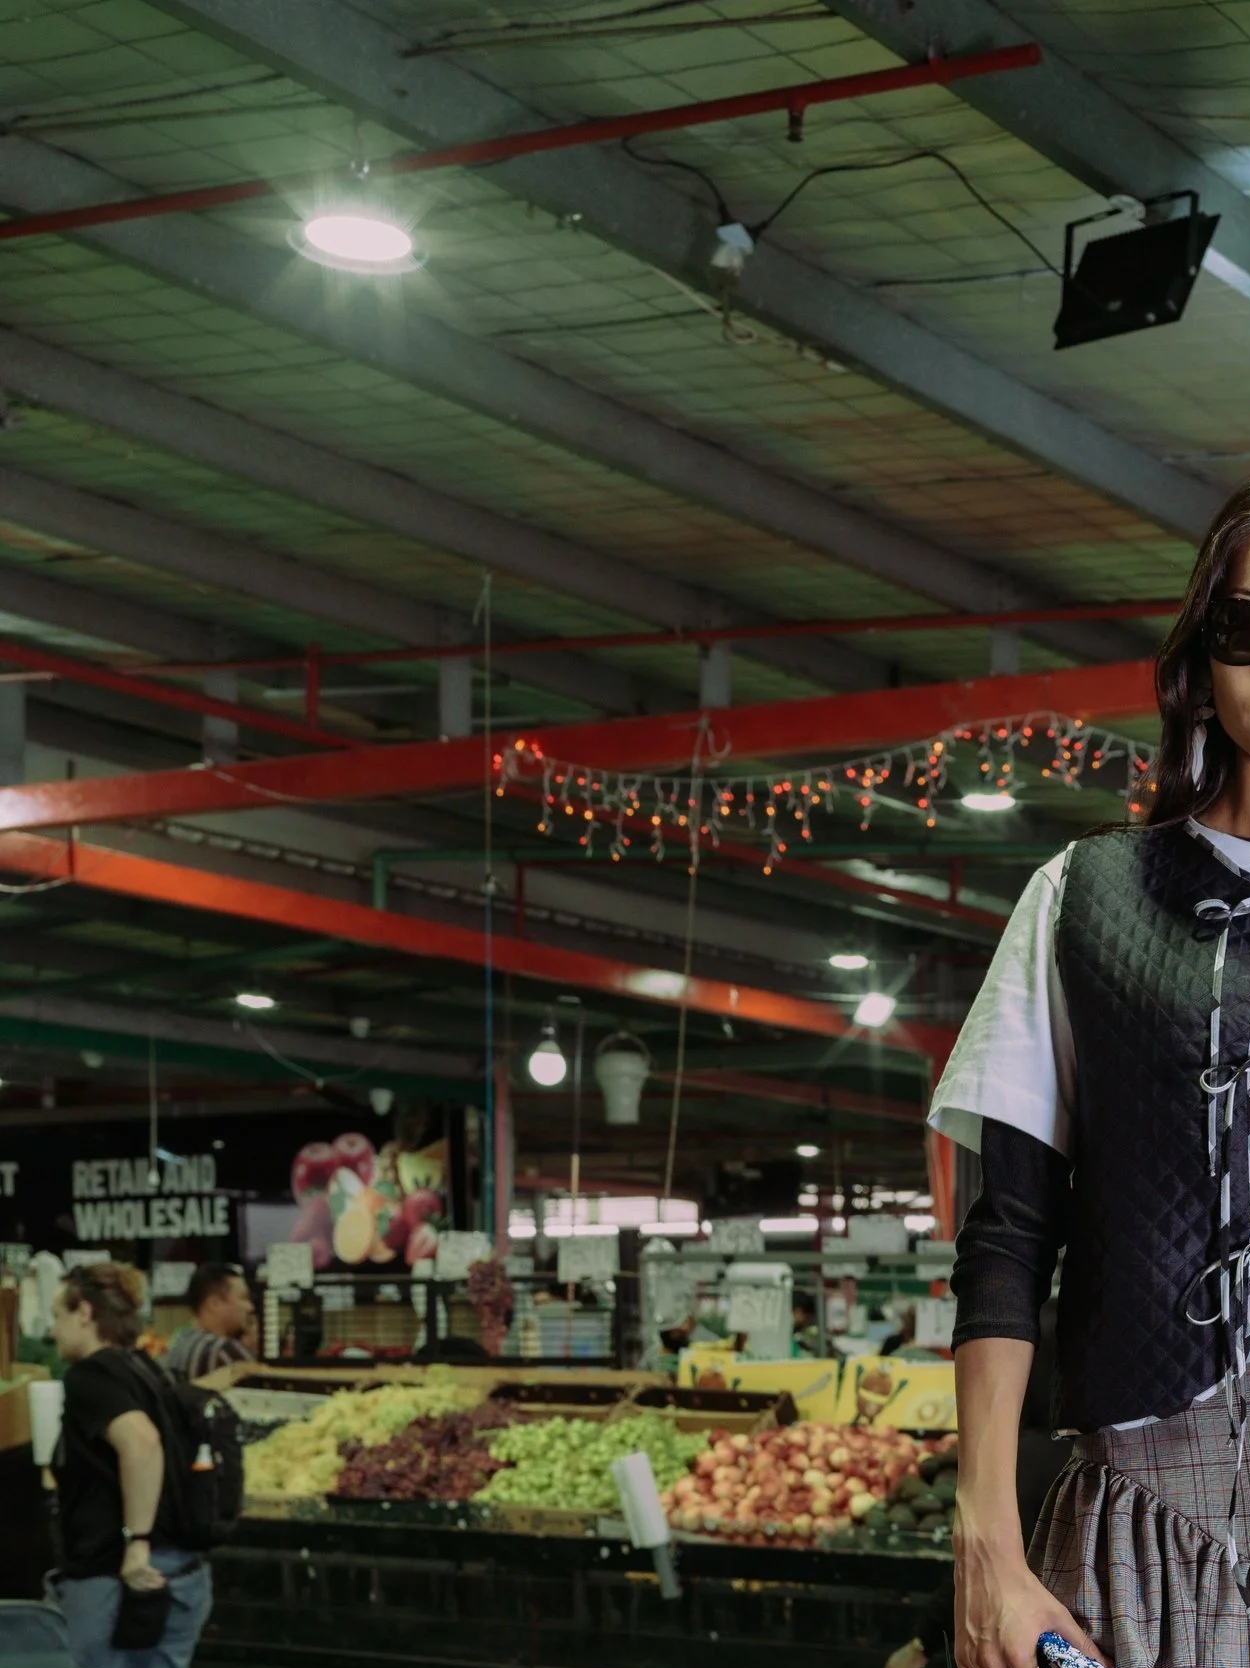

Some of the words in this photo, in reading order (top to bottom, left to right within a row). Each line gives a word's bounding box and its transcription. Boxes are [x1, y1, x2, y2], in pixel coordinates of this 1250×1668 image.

[72, 1158, 157, 1198] RETAIL
[163, 1154, 216, 1193] AND
[73, 1196, 229, 1240] WHOLESALE
